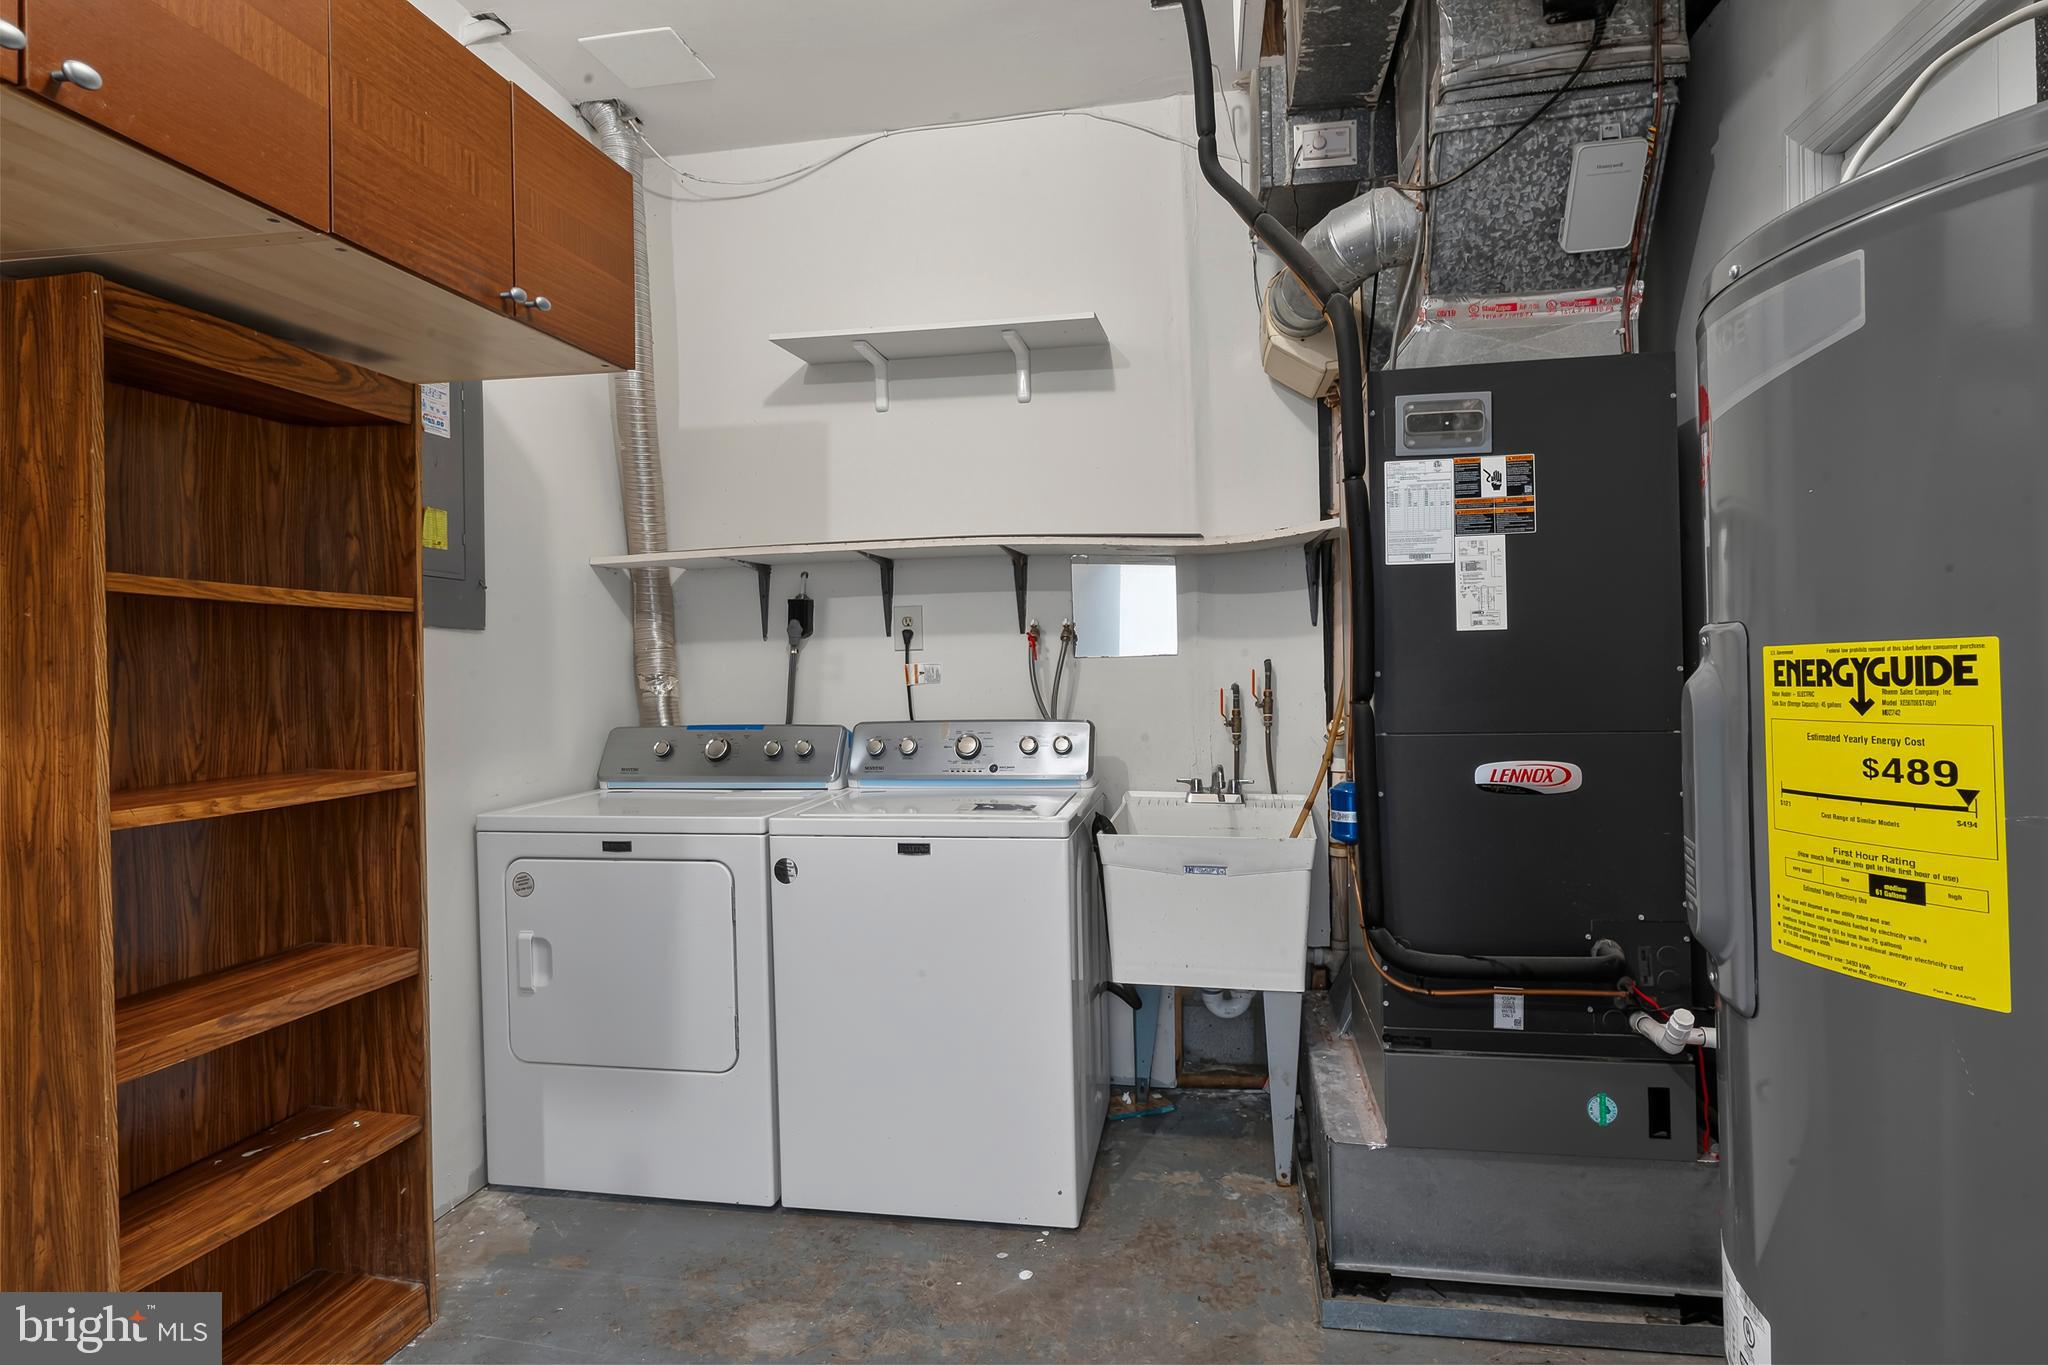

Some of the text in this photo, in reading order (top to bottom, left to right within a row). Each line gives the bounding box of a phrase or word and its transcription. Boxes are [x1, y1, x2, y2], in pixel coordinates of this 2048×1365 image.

[1774, 654, 1978, 688] ENERGYGUIDE
[1807, 732, 1925, 747] Estimated Yearly Energy Cost
[1490, 768, 1556, 783] LENNOX
[1862, 757, 1958, 787] $489
[1833, 813, 1848, 822] Range
[1878, 819, 1900, 828] Models
[1956, 820, 1978, 828] $494
[1833, 847, 1916, 869] First Hour Rating
[1886, 865, 1896, 873] the
[1914, 870, 1930, 878] hour
[1943, 875, 1959, 883] use)
[1884, 884, 1907, 893] medium
[1884, 891, 1906, 900] Gallons
[1878, 928, 1906, 941] electricity
[1864, 945, 1886, 954] national
[1888, 951, 1912, 961] average
[1915, 957, 1948, 969] electricity
